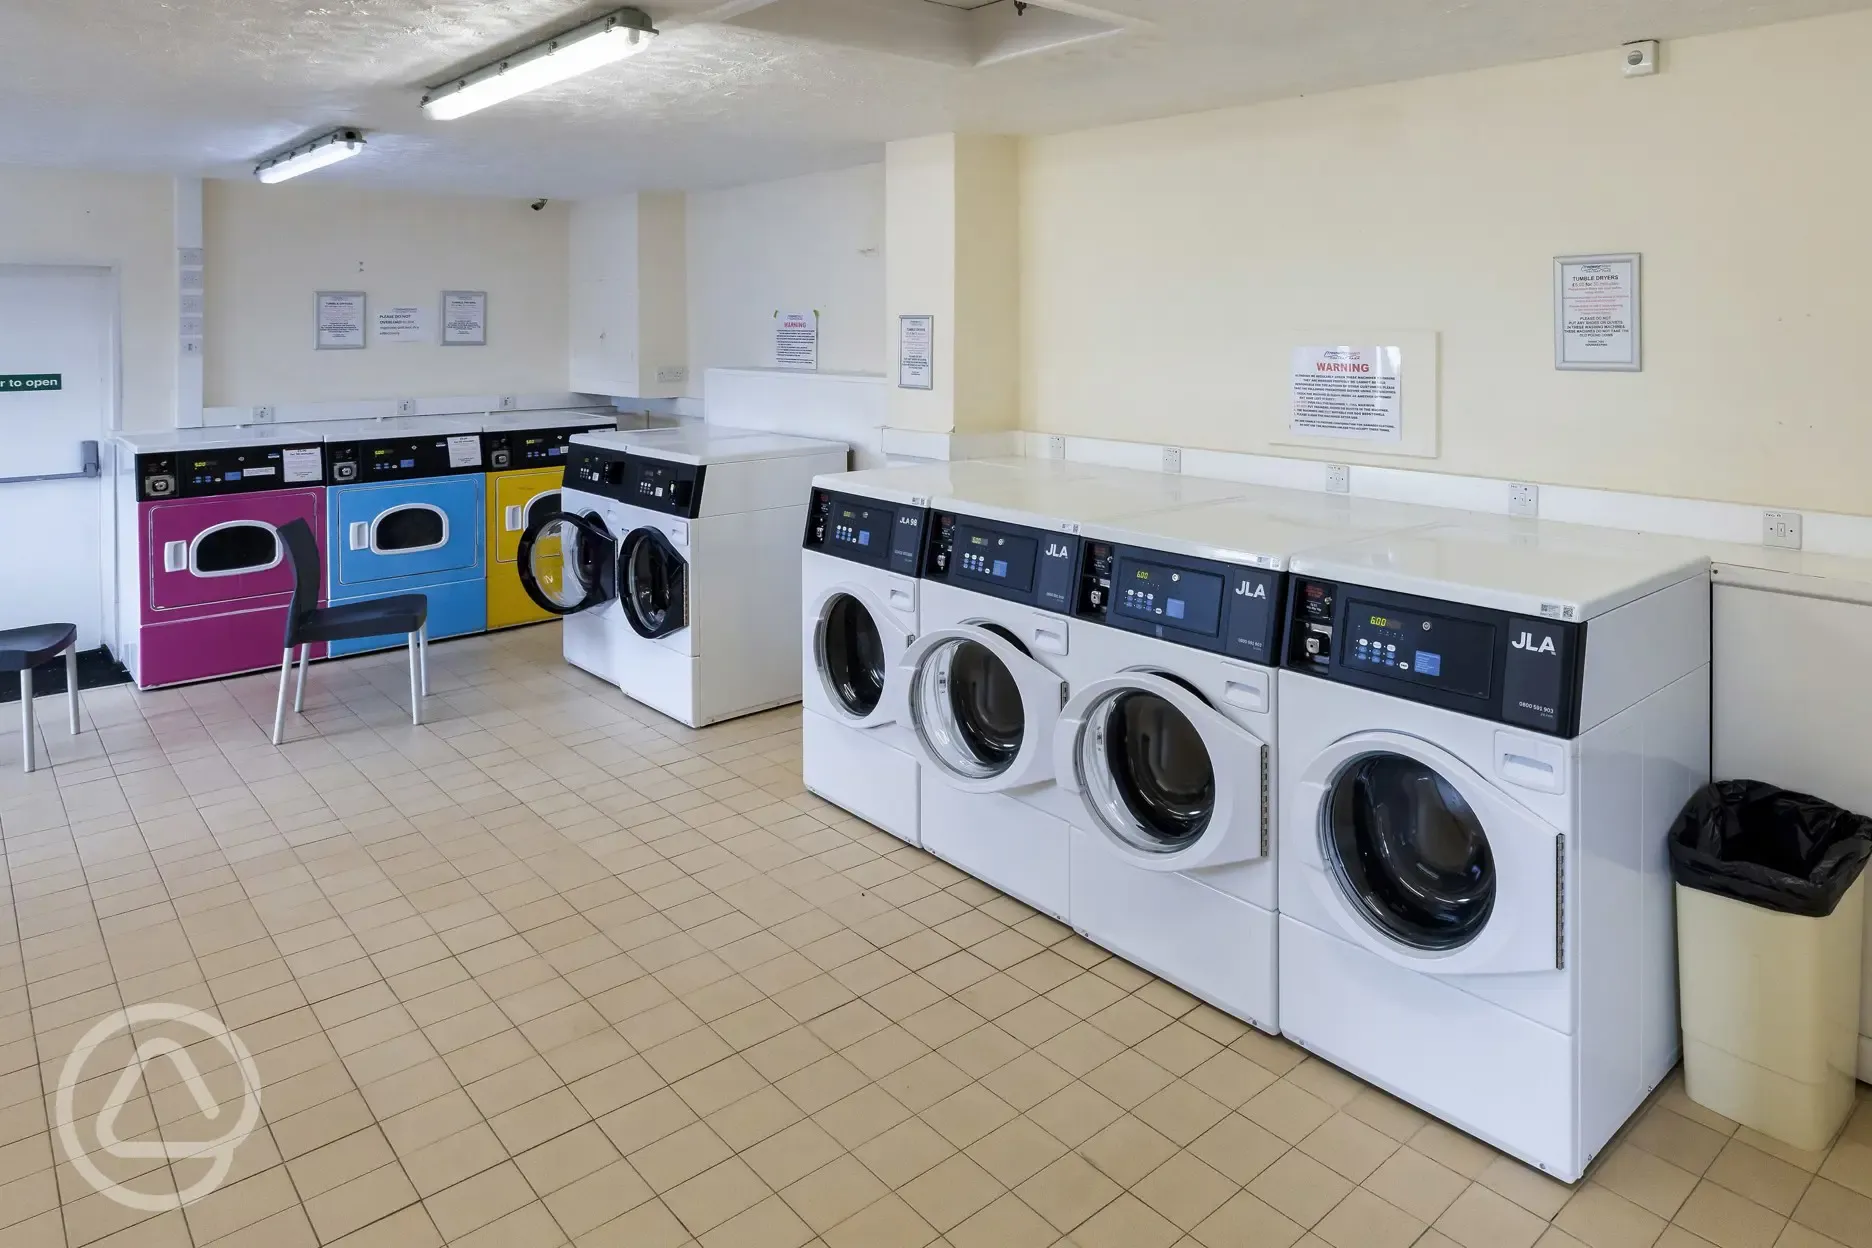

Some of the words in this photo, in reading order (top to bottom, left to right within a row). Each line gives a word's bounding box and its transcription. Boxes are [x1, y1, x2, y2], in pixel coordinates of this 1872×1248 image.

[1316, 362, 1369, 372] WARNING
[9, 379, 22, 387] to
[26, 380, 58, 388] open
[1045, 543, 1068, 558] JLA
[1235, 580, 1266, 600] JLA
[1512, 632, 1556, 656] JLA
